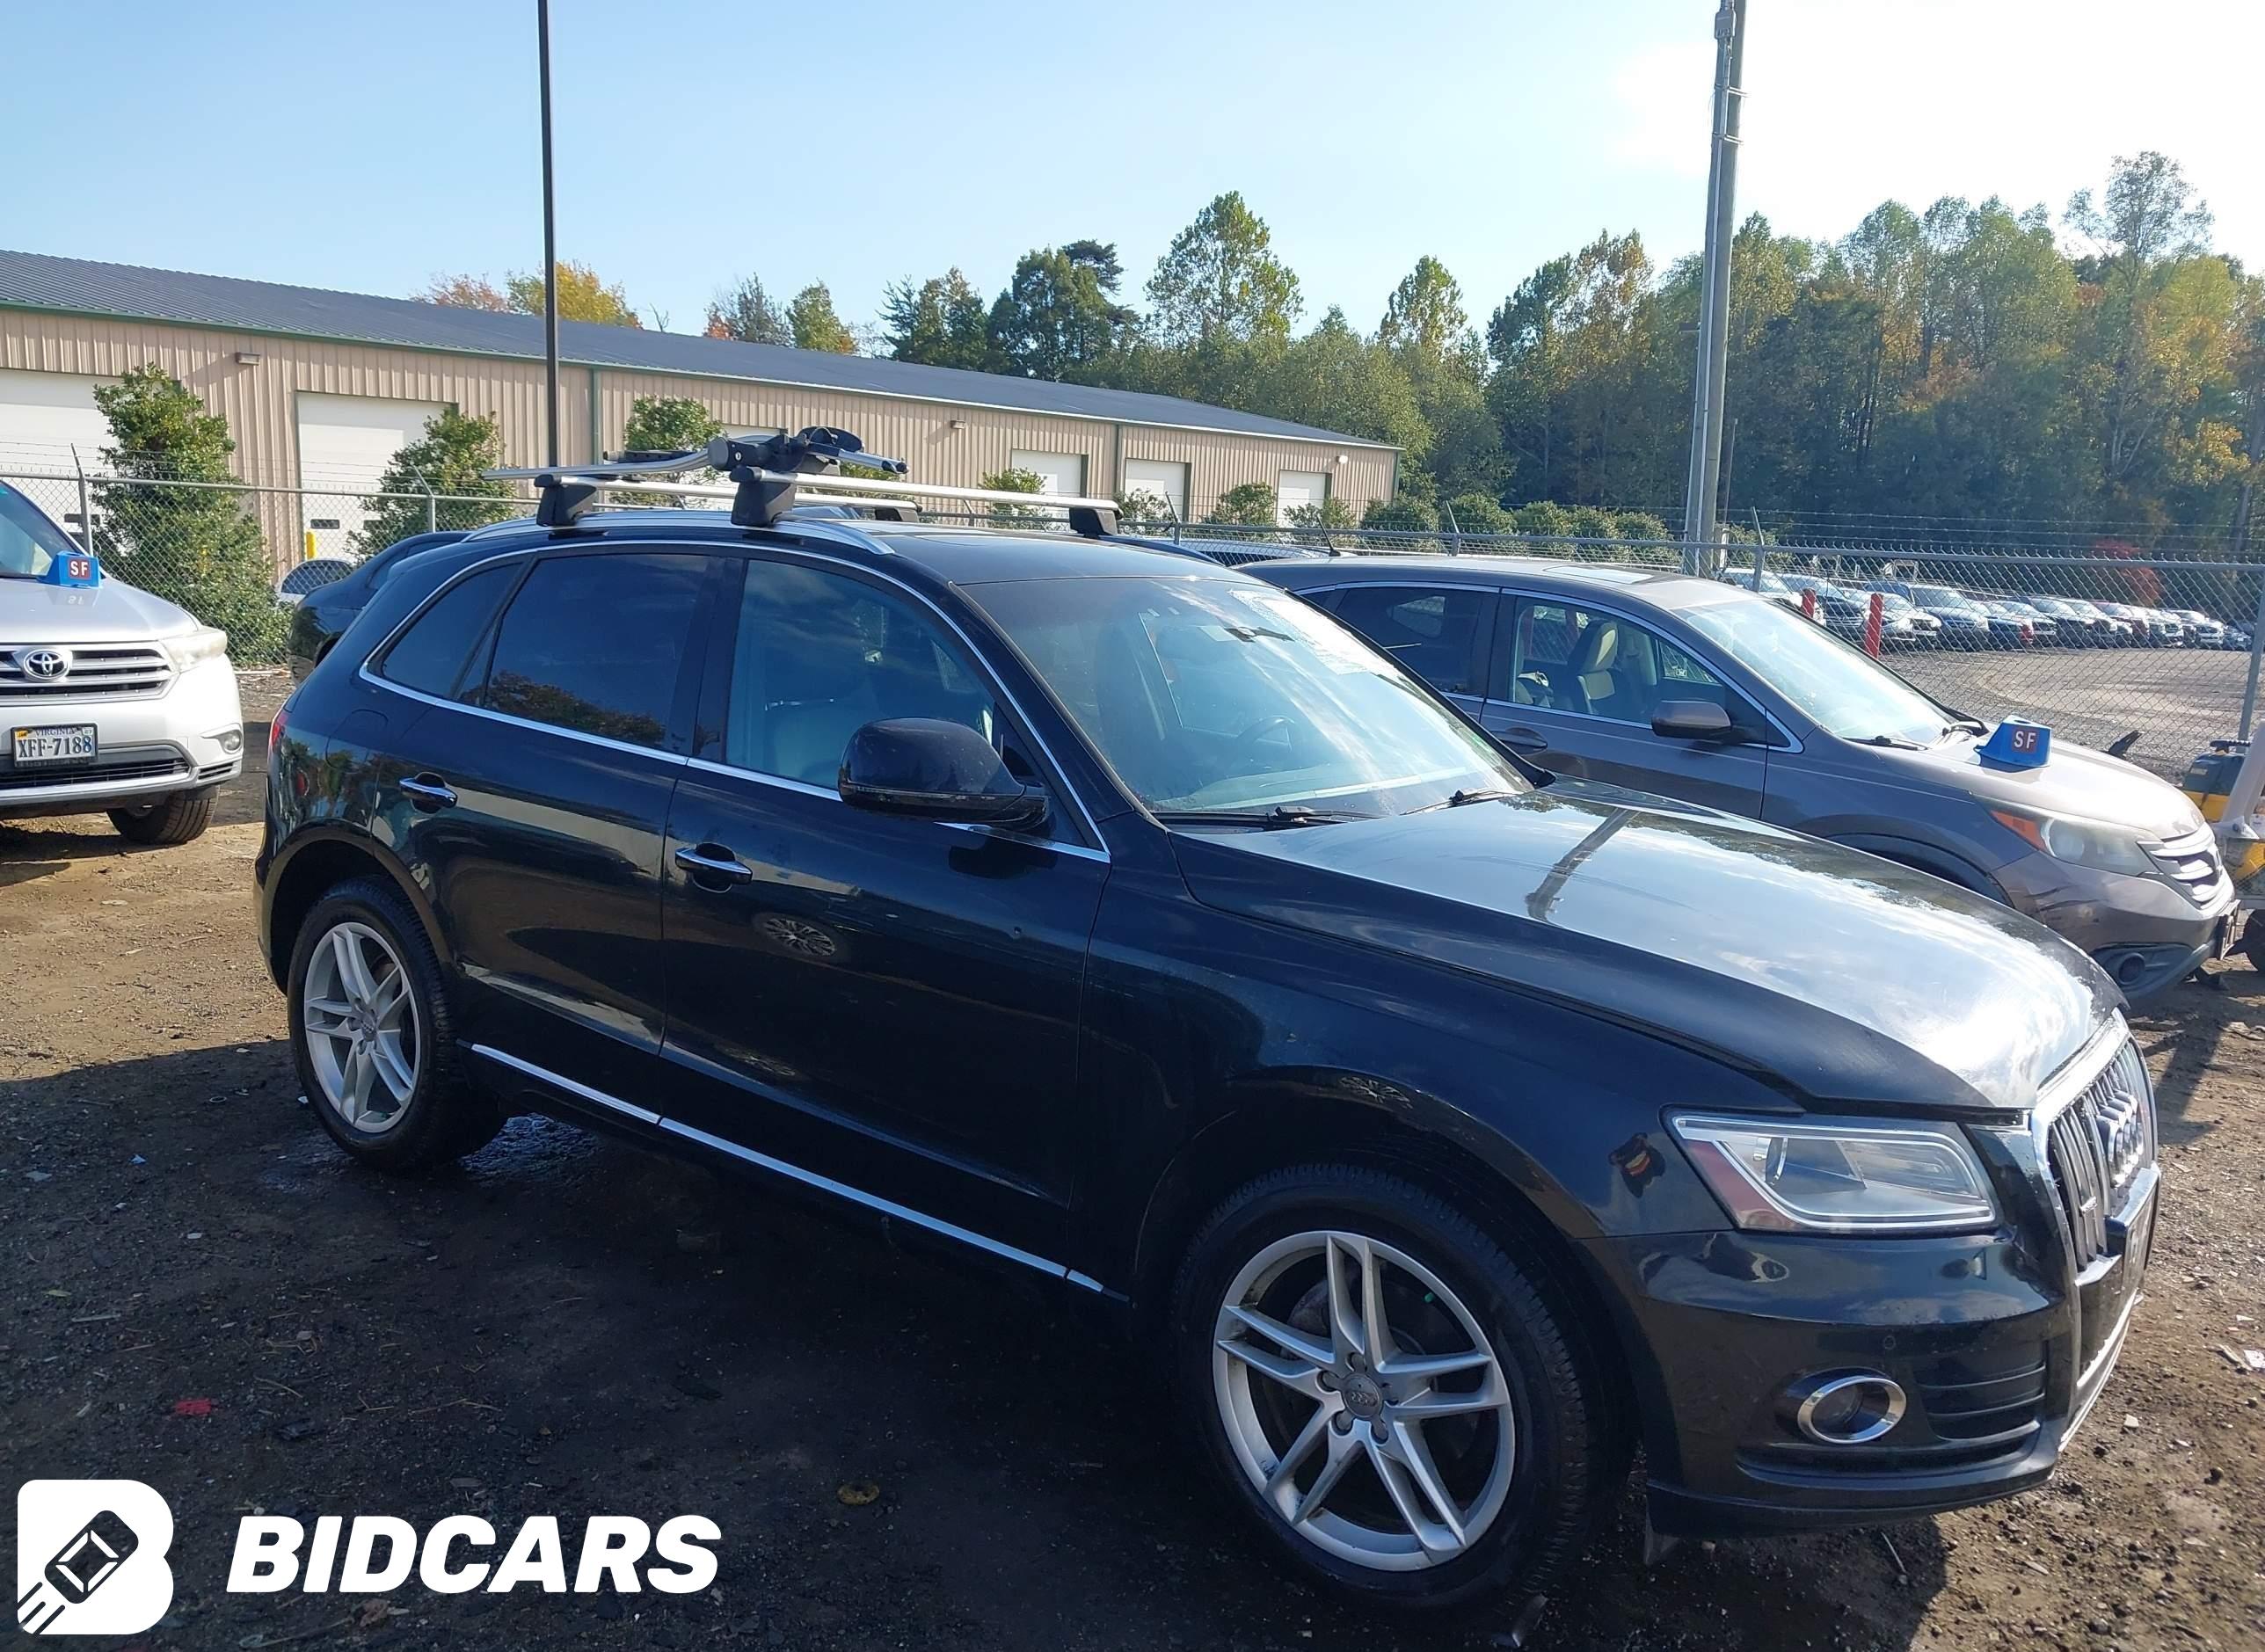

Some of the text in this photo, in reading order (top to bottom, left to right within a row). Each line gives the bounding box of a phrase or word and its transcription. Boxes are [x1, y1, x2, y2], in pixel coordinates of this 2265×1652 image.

[70, 560, 88, 576] SF
[35, 727, 76, 736] VIRGINIA
[2014, 731, 2036, 749] SF
[18, 736, 92, 757] XFF-7188
